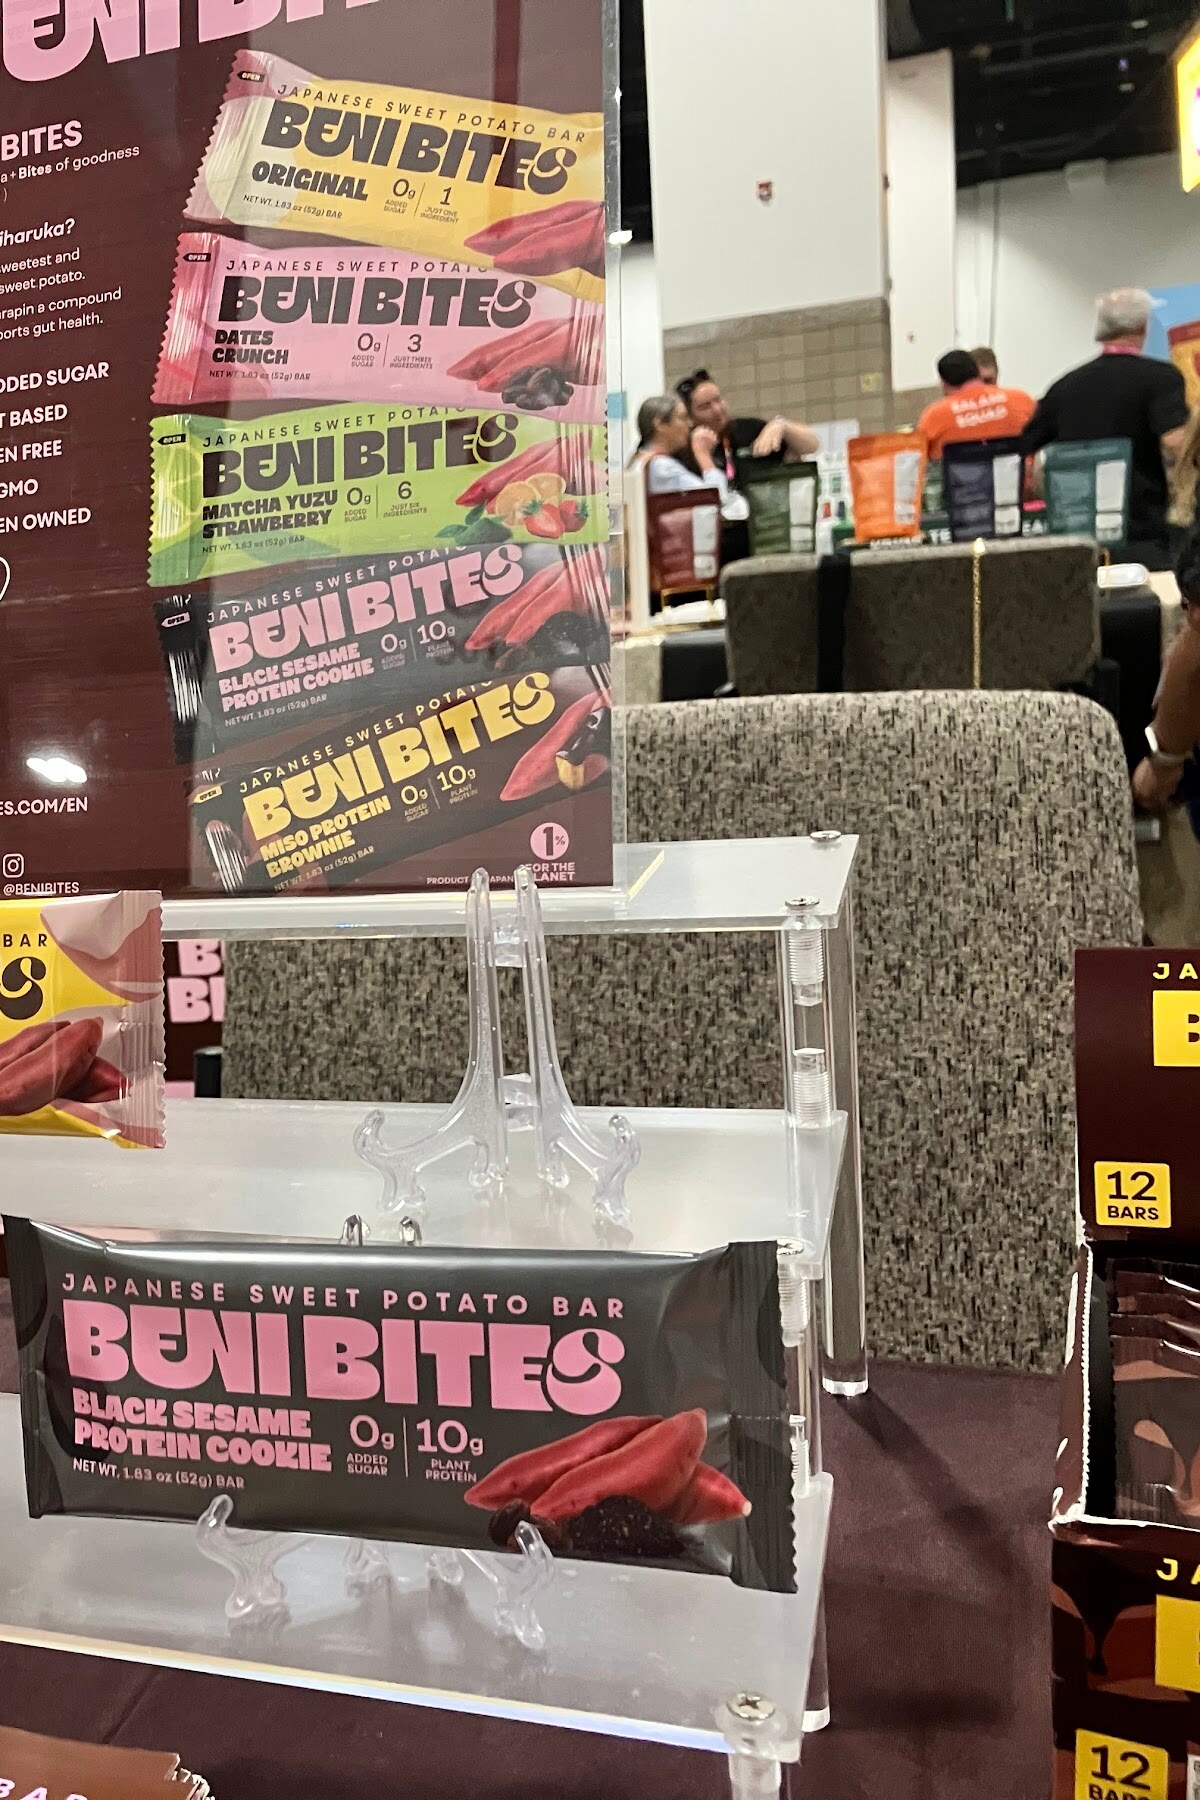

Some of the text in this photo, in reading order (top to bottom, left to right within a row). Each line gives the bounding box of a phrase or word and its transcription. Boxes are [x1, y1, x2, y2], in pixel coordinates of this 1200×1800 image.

[277, 84, 585, 143] JAPANESE SWEET POTATO BAR
[1, 120, 83, 161] BITES
[261, 99, 578, 195] BENI BITES
[19, 164, 52, 180] Bites
[55, 158, 70, 172] of
[73, 145, 140, 171] goodness
[252, 161, 368, 201] ORIGINAL
[244, 194, 258, 204] NET
[326, 210, 342, 218] BAR
[440, 187, 452, 206] 1
[55, 248, 81, 265] and
[38, 269, 86, 290] potato.
[37, 302, 45, 313] a
[48, 287, 122, 312] compound
[33, 321, 56, 338] gut
[58, 312, 104, 331] health.
[215, 330, 273, 345] DATES
[408, 334, 422, 352] 3
[212, 348, 289, 365] CRUNCH
[46, 361, 109, 386] SUGAR
[9, 404, 68, 427] BASED
[22, 439, 62, 460] FREE
[203, 413, 519, 498] BENI BITES
[398, 481, 412, 499] 6
[203, 490, 338, 521] MATCHA YUZU
[22, 507, 91, 531] OWNED
[203, 509, 332, 539] STRAWBERRY
[218, 643, 360, 695] BLACK SESAME
[222, 658, 374, 713] PROTEIN COOKIE
[243, 672, 555, 841] BENI BITES
[260, 795, 391, 861] MISO PROTEIN
[266, 830, 355, 879] BROWNIE
[551, 862, 575, 871] THE
[427, 876, 469, 885] PRODUCT
[3, 934, 48, 947] BAR
[1107, 1170, 1157, 1202] 12
[1107, 1205, 1159, 1220] BARS
[62, 1273, 624, 1319] JAPANESE SWEET POTATO BAR
[63, 1298, 625, 1416] BENI BITES
[72, 1387, 312, 1438] BLACK SESAME
[74, 1417, 332, 1472] PROTEIN COOKIE
[350, 1414, 395, 1450] 0g
[416, 1418, 484, 1456] 10g
[346, 1452, 388, 1466] ADDED
[347, 1463, 388, 1477] SUGAR
[431, 1458, 470, 1471] PLANT
[73, 1457, 96, 1473] NET
[98, 1462, 120, 1478] WT.
[156, 1472, 172, 1484] oz
[175, 1472, 213, 1488] (52g)
[216, 1474, 246, 1489] BAR
[425, 1469, 477, 1483] PROTEIN
